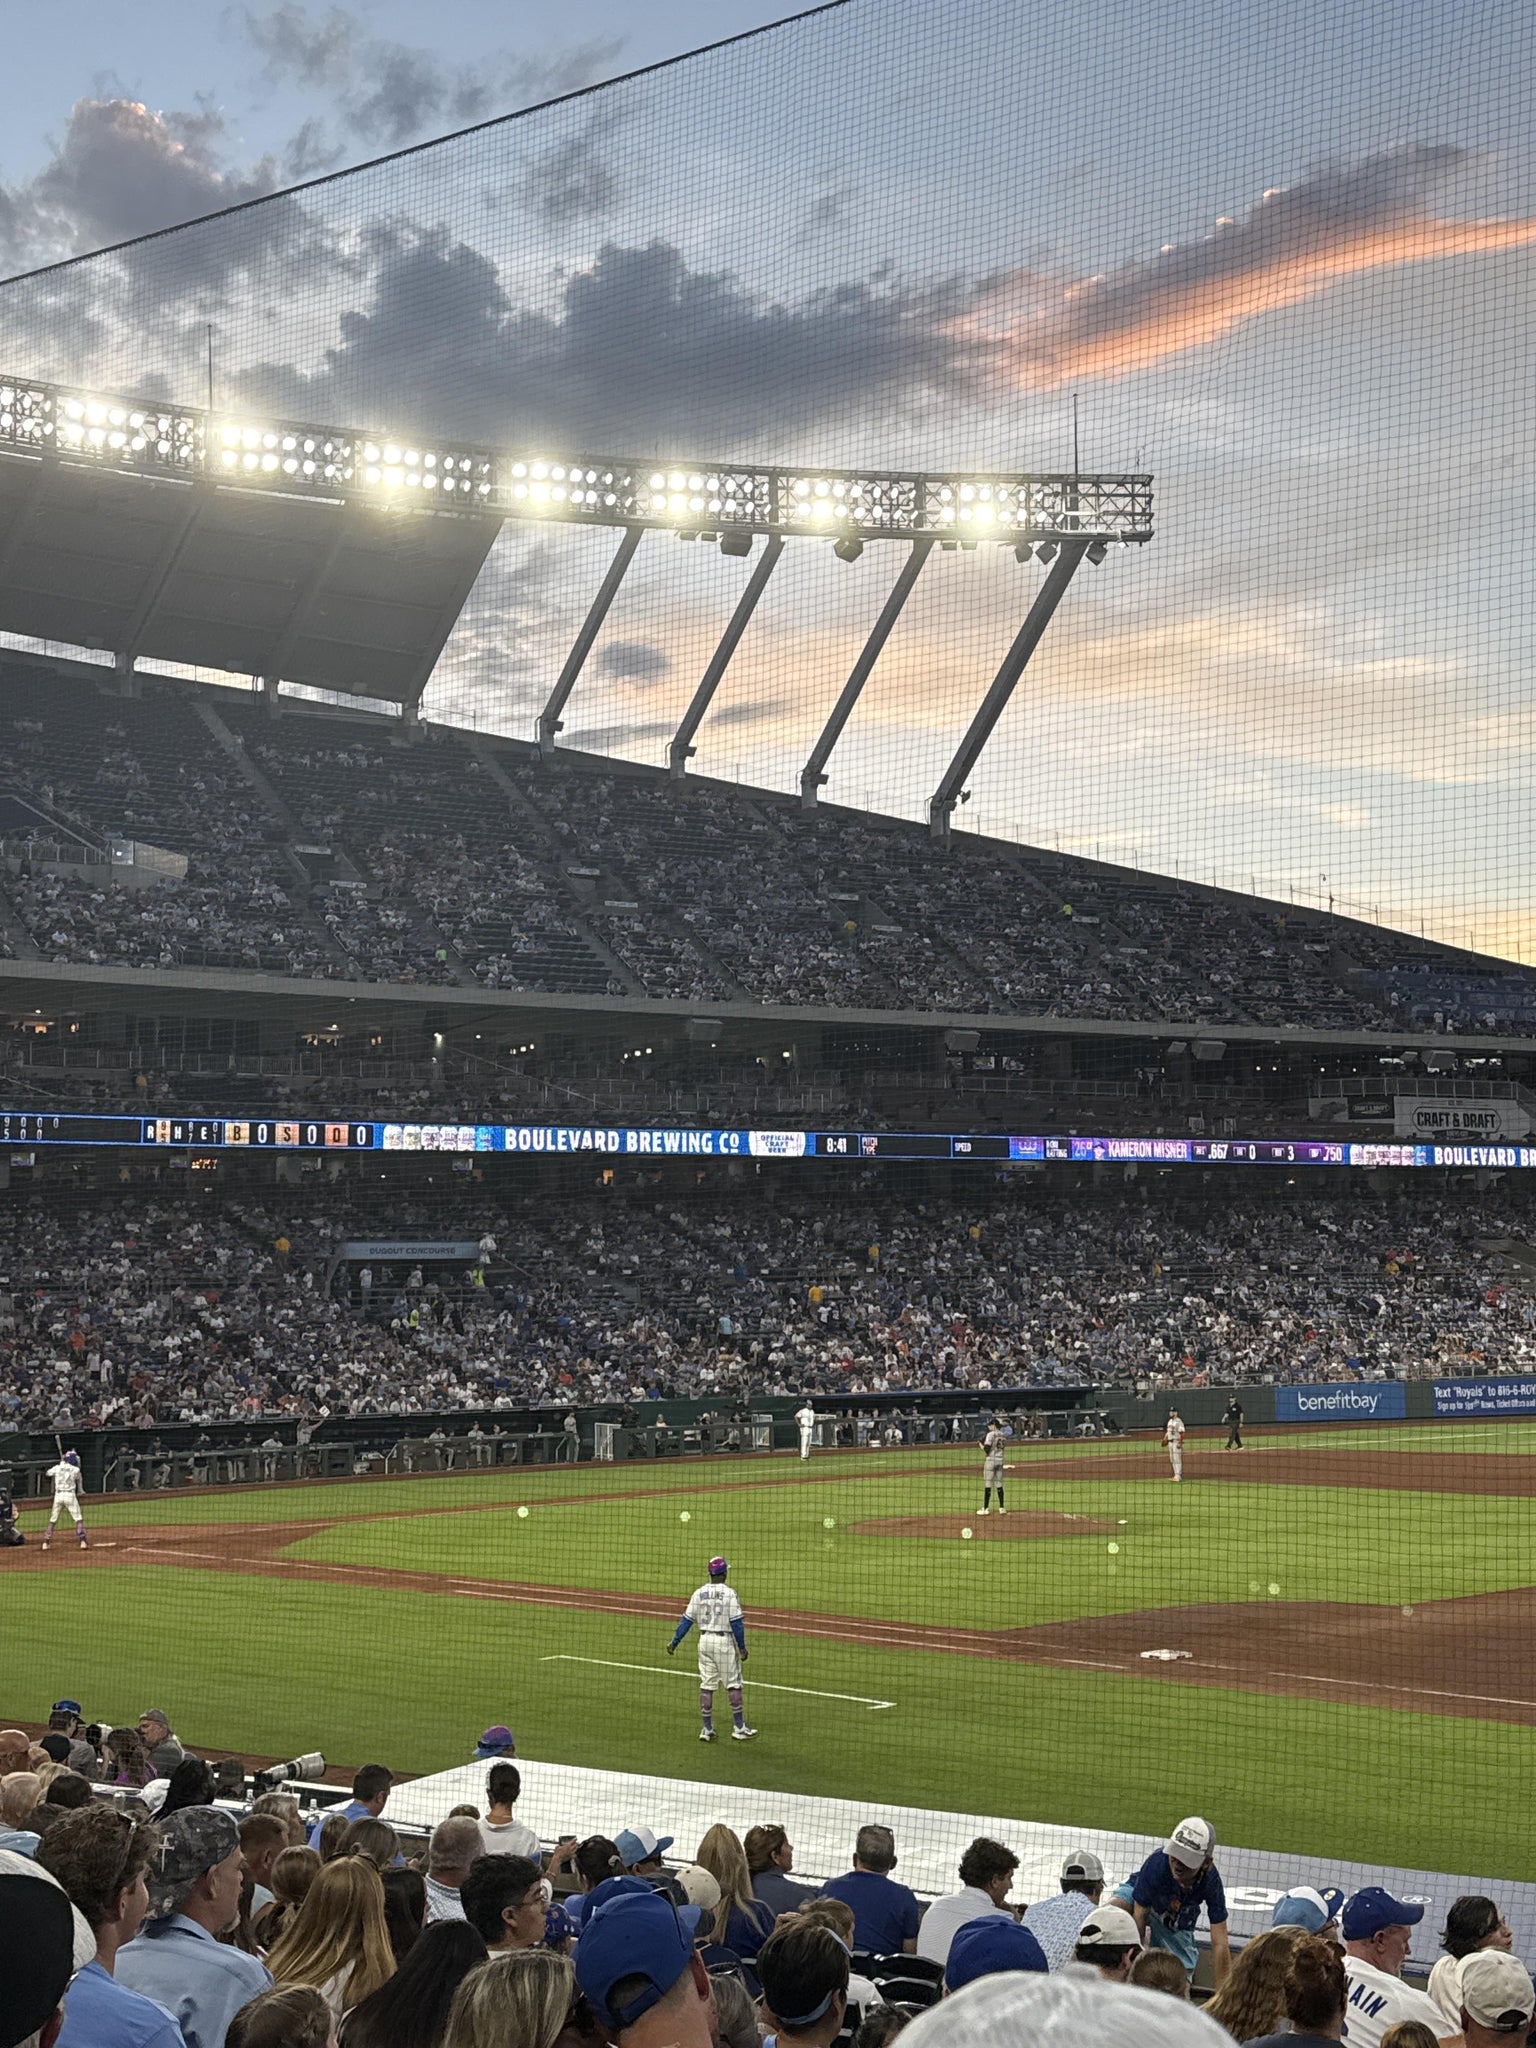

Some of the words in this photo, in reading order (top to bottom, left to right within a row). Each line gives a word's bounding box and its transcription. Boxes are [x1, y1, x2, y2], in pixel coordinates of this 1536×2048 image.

[4, 1116, 10, 1127] 9
[20, 1117, 26, 1128] 0
[36, 1118, 42, 1128] 0
[53, 1118, 59, 1128] 0
[1416, 1112, 1450, 1127] CRAFT
[1453, 1112, 1460, 1127] &
[1464, 1112, 1496, 1128] DRAFT
[4, 1128, 10, 1139] 5
[20, 1129, 26, 1140] 0
[36, 1129, 42, 1140] 0
[147, 1126, 154, 1139] R
[174, 1126, 182, 1140] H
[188, 1133, 193, 1144] 7
[201, 1126, 208, 1140] E
[233, 1126, 241, 1141] B
[258, 1124, 268, 1143] 0
[284, 1126, 292, 1142] S
[307, 1125, 317, 1144] 0
[356, 1126, 366, 1145] 0
[505, 1128, 620, 1152] BOULEVARD
[626, 1131, 714, 1153] BREWING
[827, 1138, 846, 1153] 8:41
[955, 1142, 971, 1152] SPEED
[1075, 1141, 1086, 1157] 26
[1108, 1142, 1152, 1158] KAMERON
[1154, 1142, 1187, 1159] MISNER
[1208, 1144, 1228, 1159] .667
[1249, 1144, 1256, 1160] 0
[1288, 1146, 1294, 1161] 3
[1323, 1146, 1342, 1161] .750
[1434, 1146, 1516, 1166] BOULEVARD
[1434, 1386, 1451, 1398] Text
[1453, 1385, 1486, 1399] "Royals"
[1488, 1386, 1496, 1396] to
[1298, 1390, 1378, 1413] benefitbay
